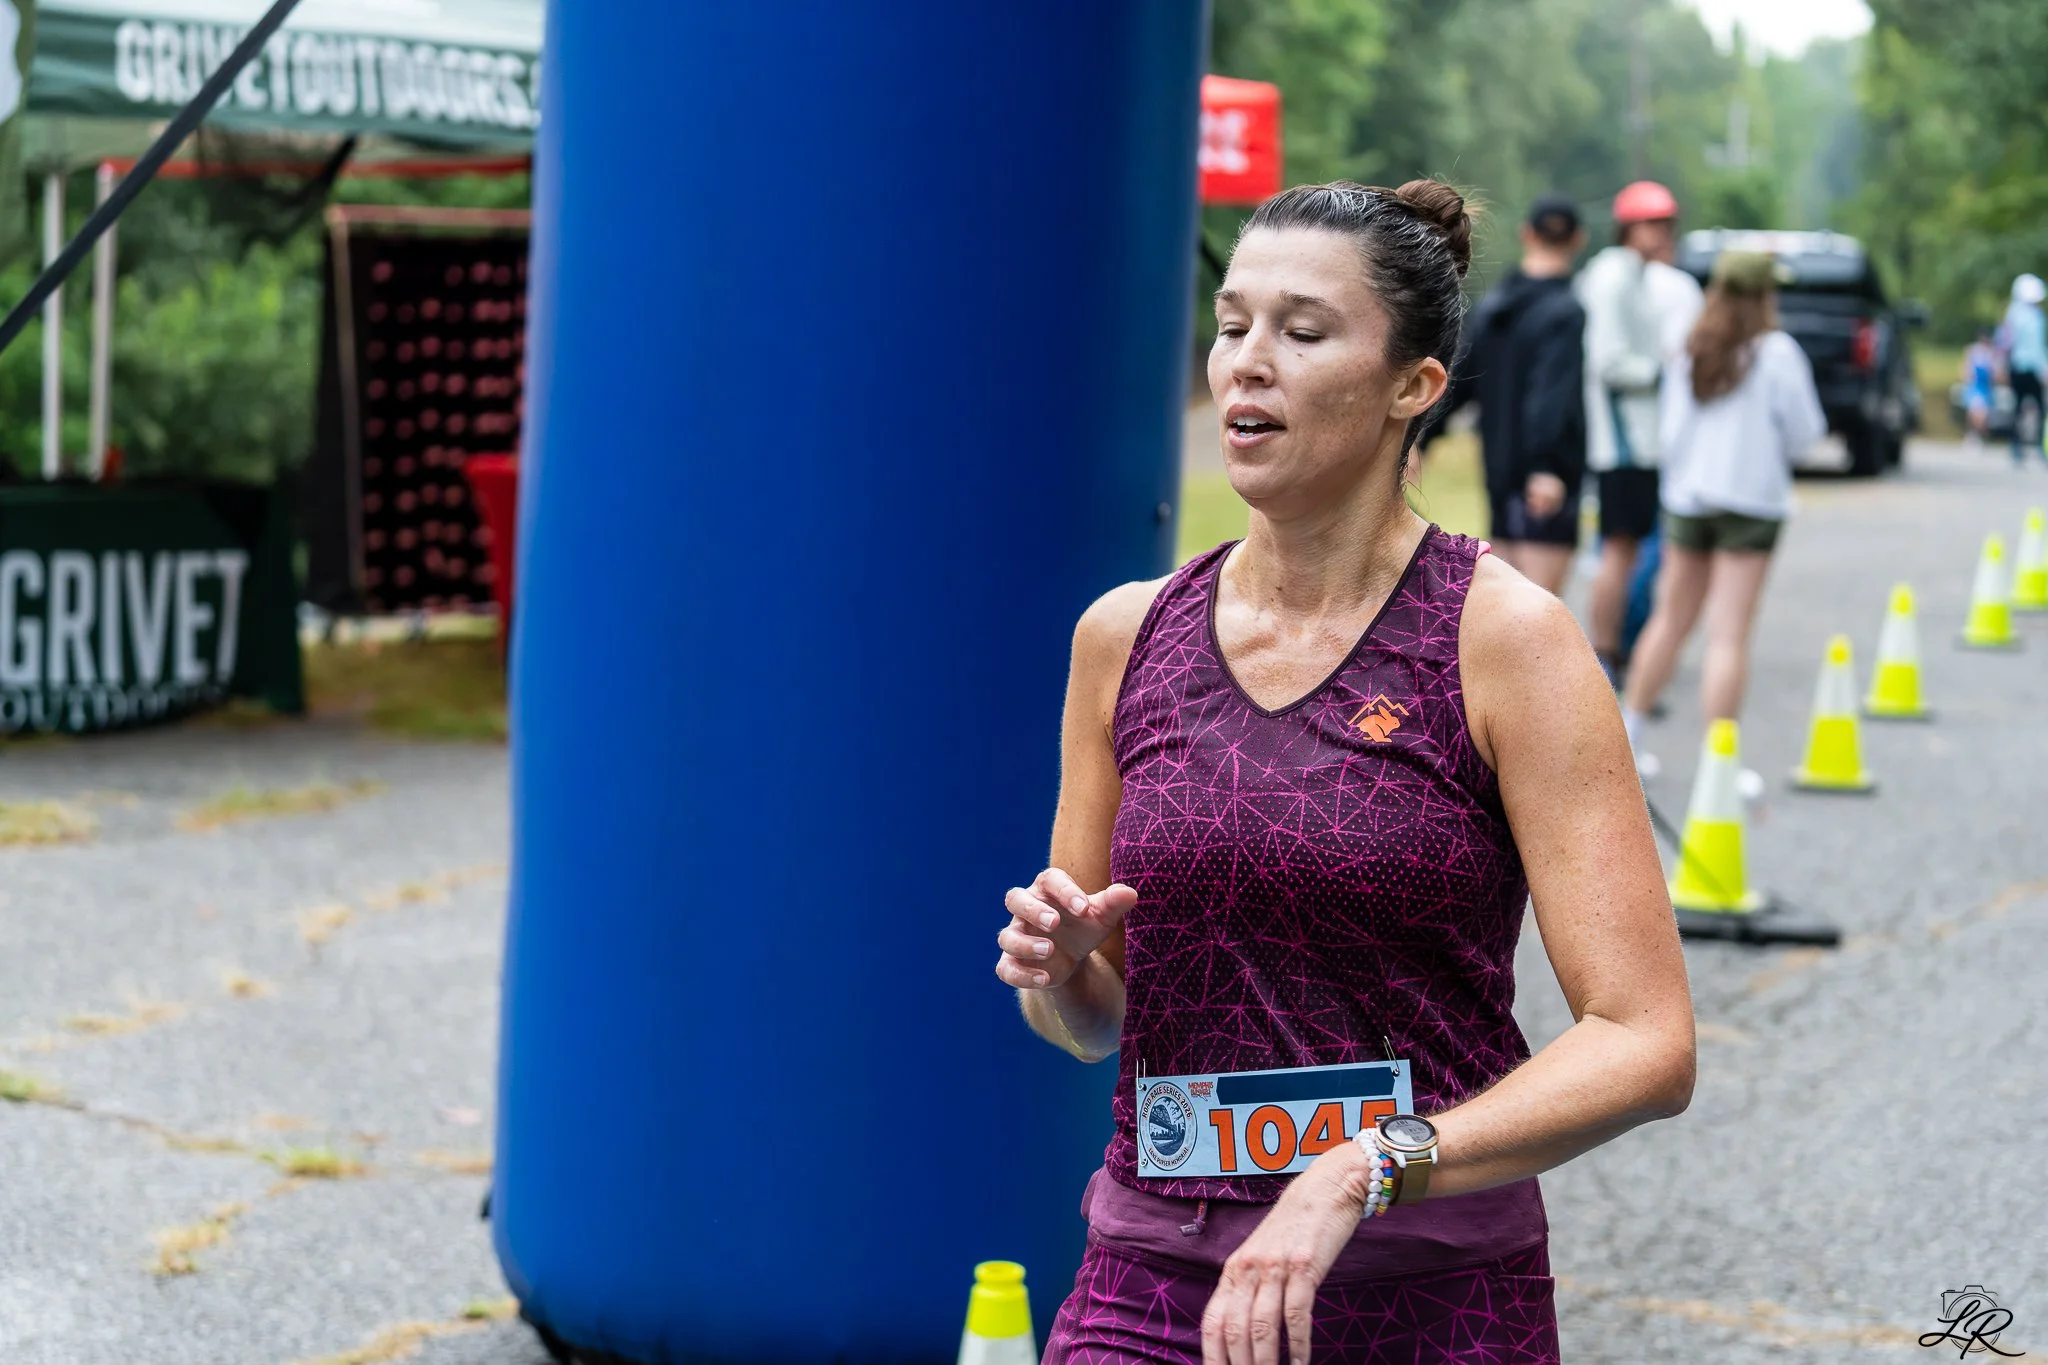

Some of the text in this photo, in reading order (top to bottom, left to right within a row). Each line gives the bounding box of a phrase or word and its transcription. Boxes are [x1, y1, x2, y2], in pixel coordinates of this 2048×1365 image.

[1142, 1098, 1152, 1118] ROAD
[1150, 1087, 1162, 1101] RACE
[1163, 1086, 1181, 1100] SERIES
